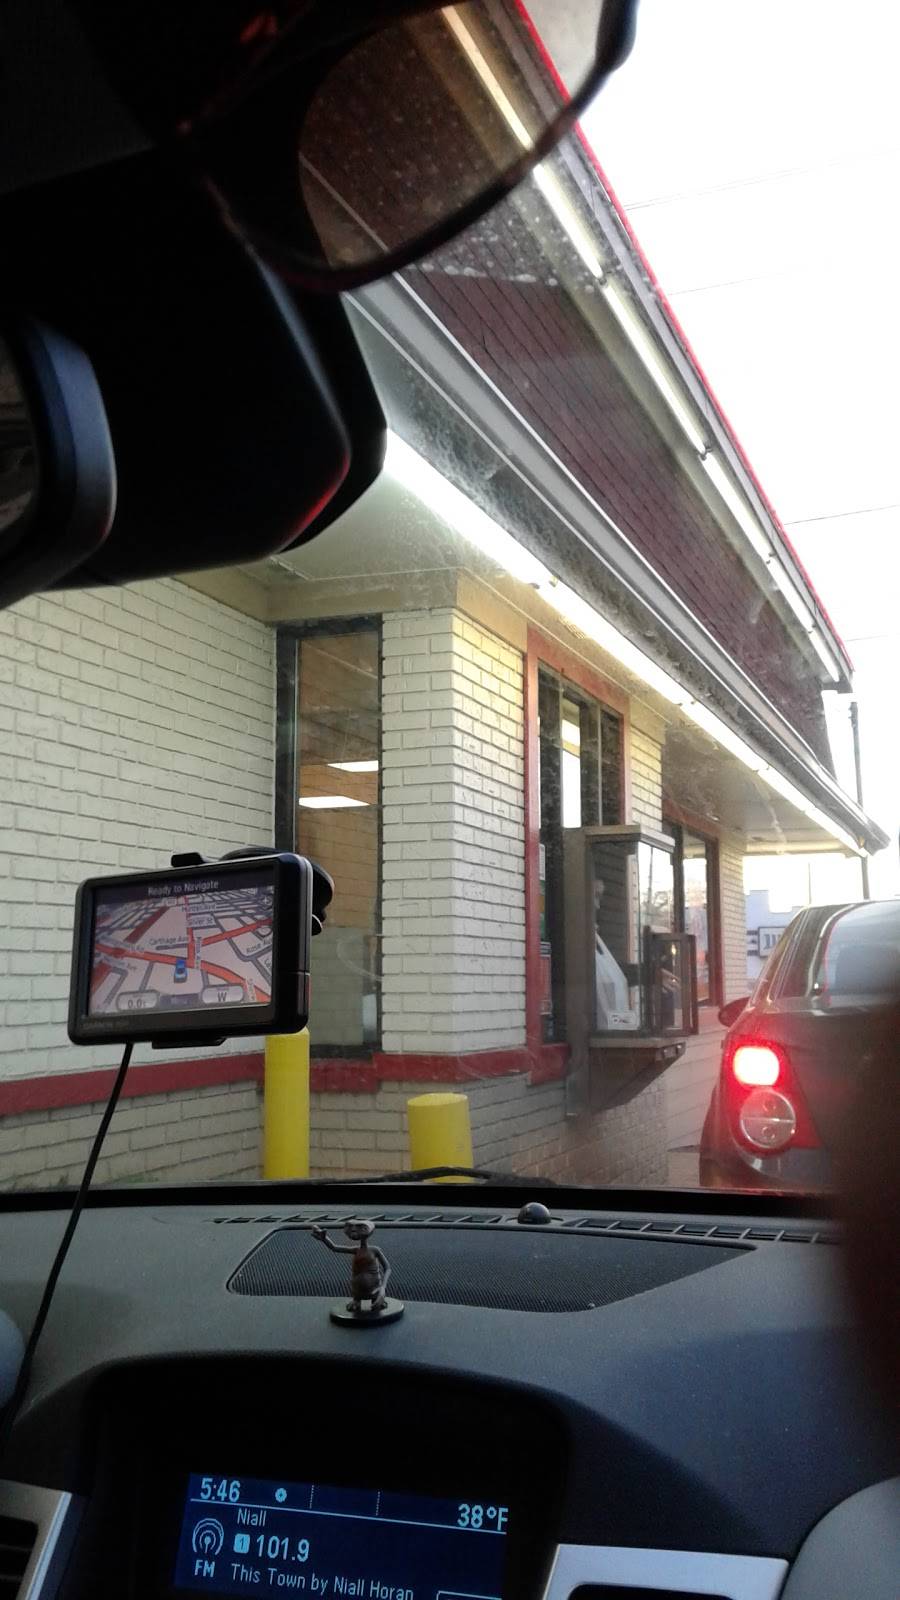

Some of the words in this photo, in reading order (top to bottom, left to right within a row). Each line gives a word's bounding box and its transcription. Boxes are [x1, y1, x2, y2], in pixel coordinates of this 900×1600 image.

[148, 886, 172, 897] Ready
[174, 884, 182, 893] to
[184, 881, 219, 894] Navigate
[217, 992, 228, 1002] W
[200, 1477, 241, 1503] 5:46
[237, 1508, 267, 1527] Niall
[457, 1503, 508, 1531] 38°F
[256, 1534, 310, 1562] 101.9
[194, 1559, 216, 1578] FM
[231, 1563, 261, 1584] This
[267, 1567, 306, 1589] Town
[310, 1573, 329, 1596] by
[333, 1575, 365, 1596] Niall
[369, 1580, 414, 1600] Horan
